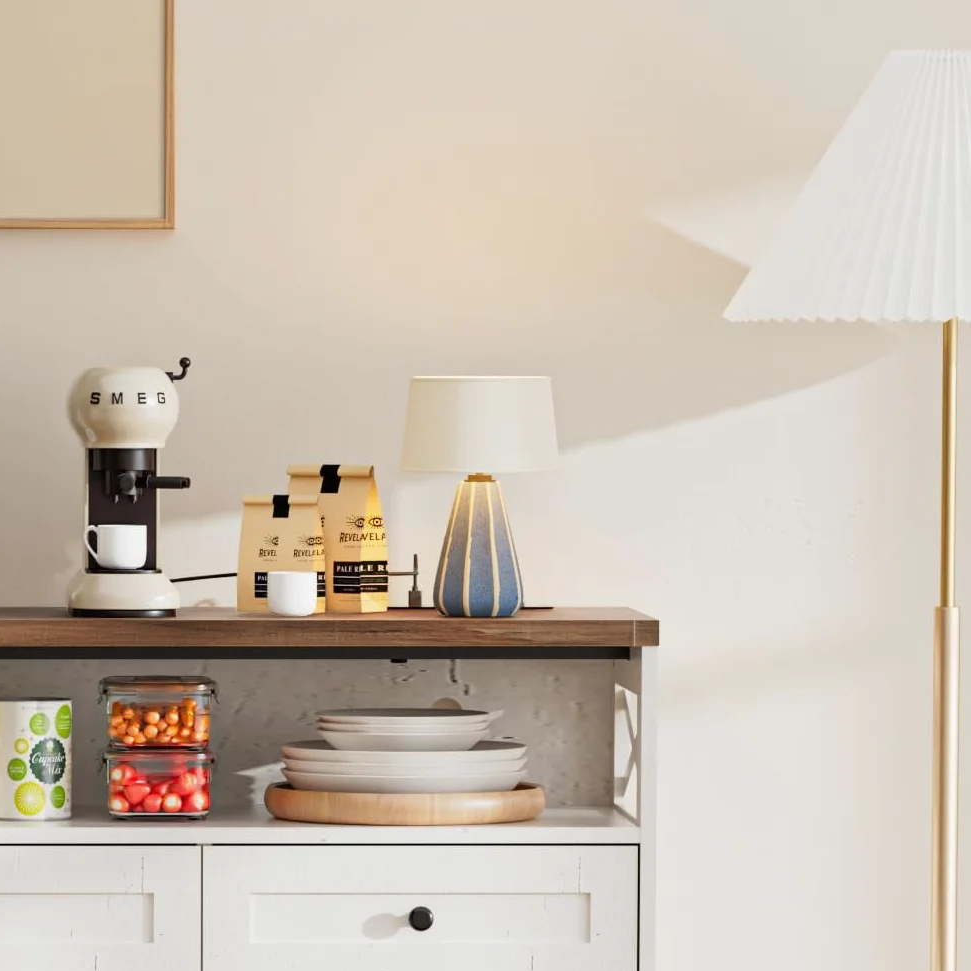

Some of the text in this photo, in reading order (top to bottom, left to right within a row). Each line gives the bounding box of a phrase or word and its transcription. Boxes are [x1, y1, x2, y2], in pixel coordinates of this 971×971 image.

[89, 392, 166, 405] SMEG
[336, 565, 353, 573] PALE
[31, 751, 65, 767] Cupcake
[46, 763, 62, 776] Mix
